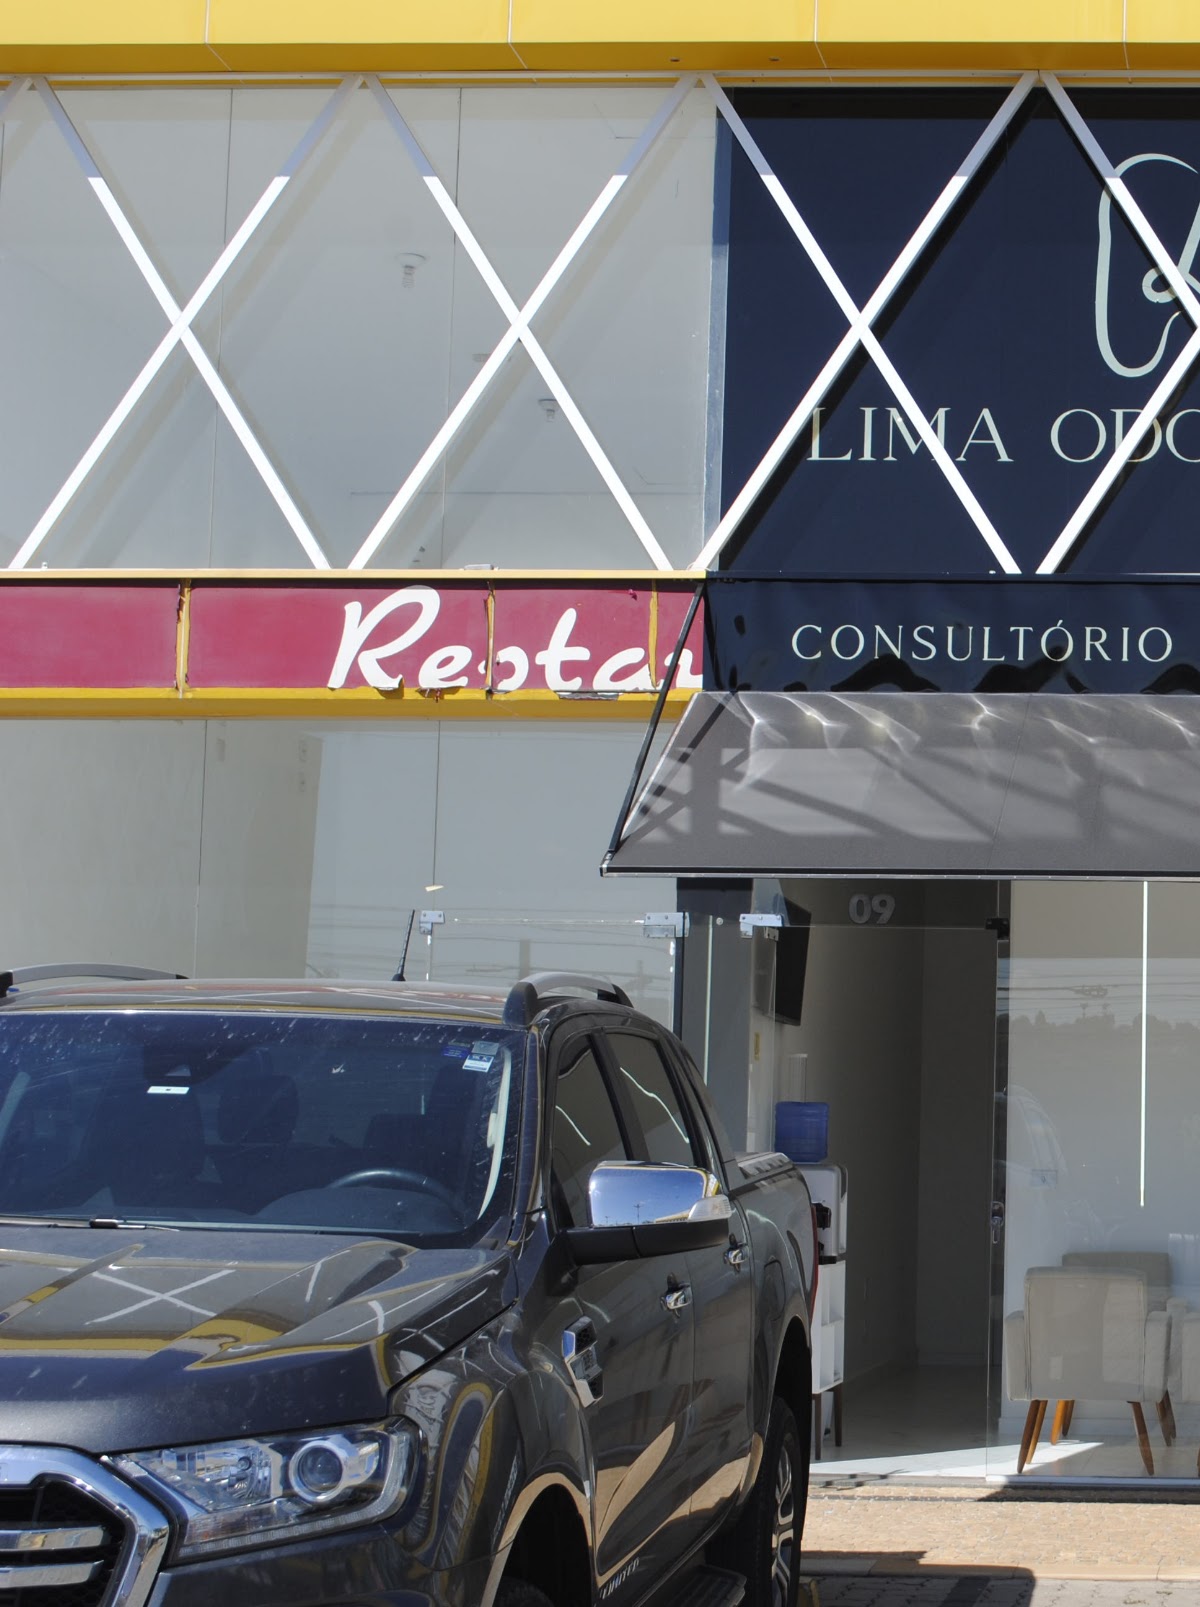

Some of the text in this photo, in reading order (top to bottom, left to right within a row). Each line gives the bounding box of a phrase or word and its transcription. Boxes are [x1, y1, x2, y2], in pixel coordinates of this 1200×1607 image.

[806, 406, 1014, 463] LIMA
[790, 620, 1174, 663] CONSULTÓRIO
[848, 894, 896, 925] 09
